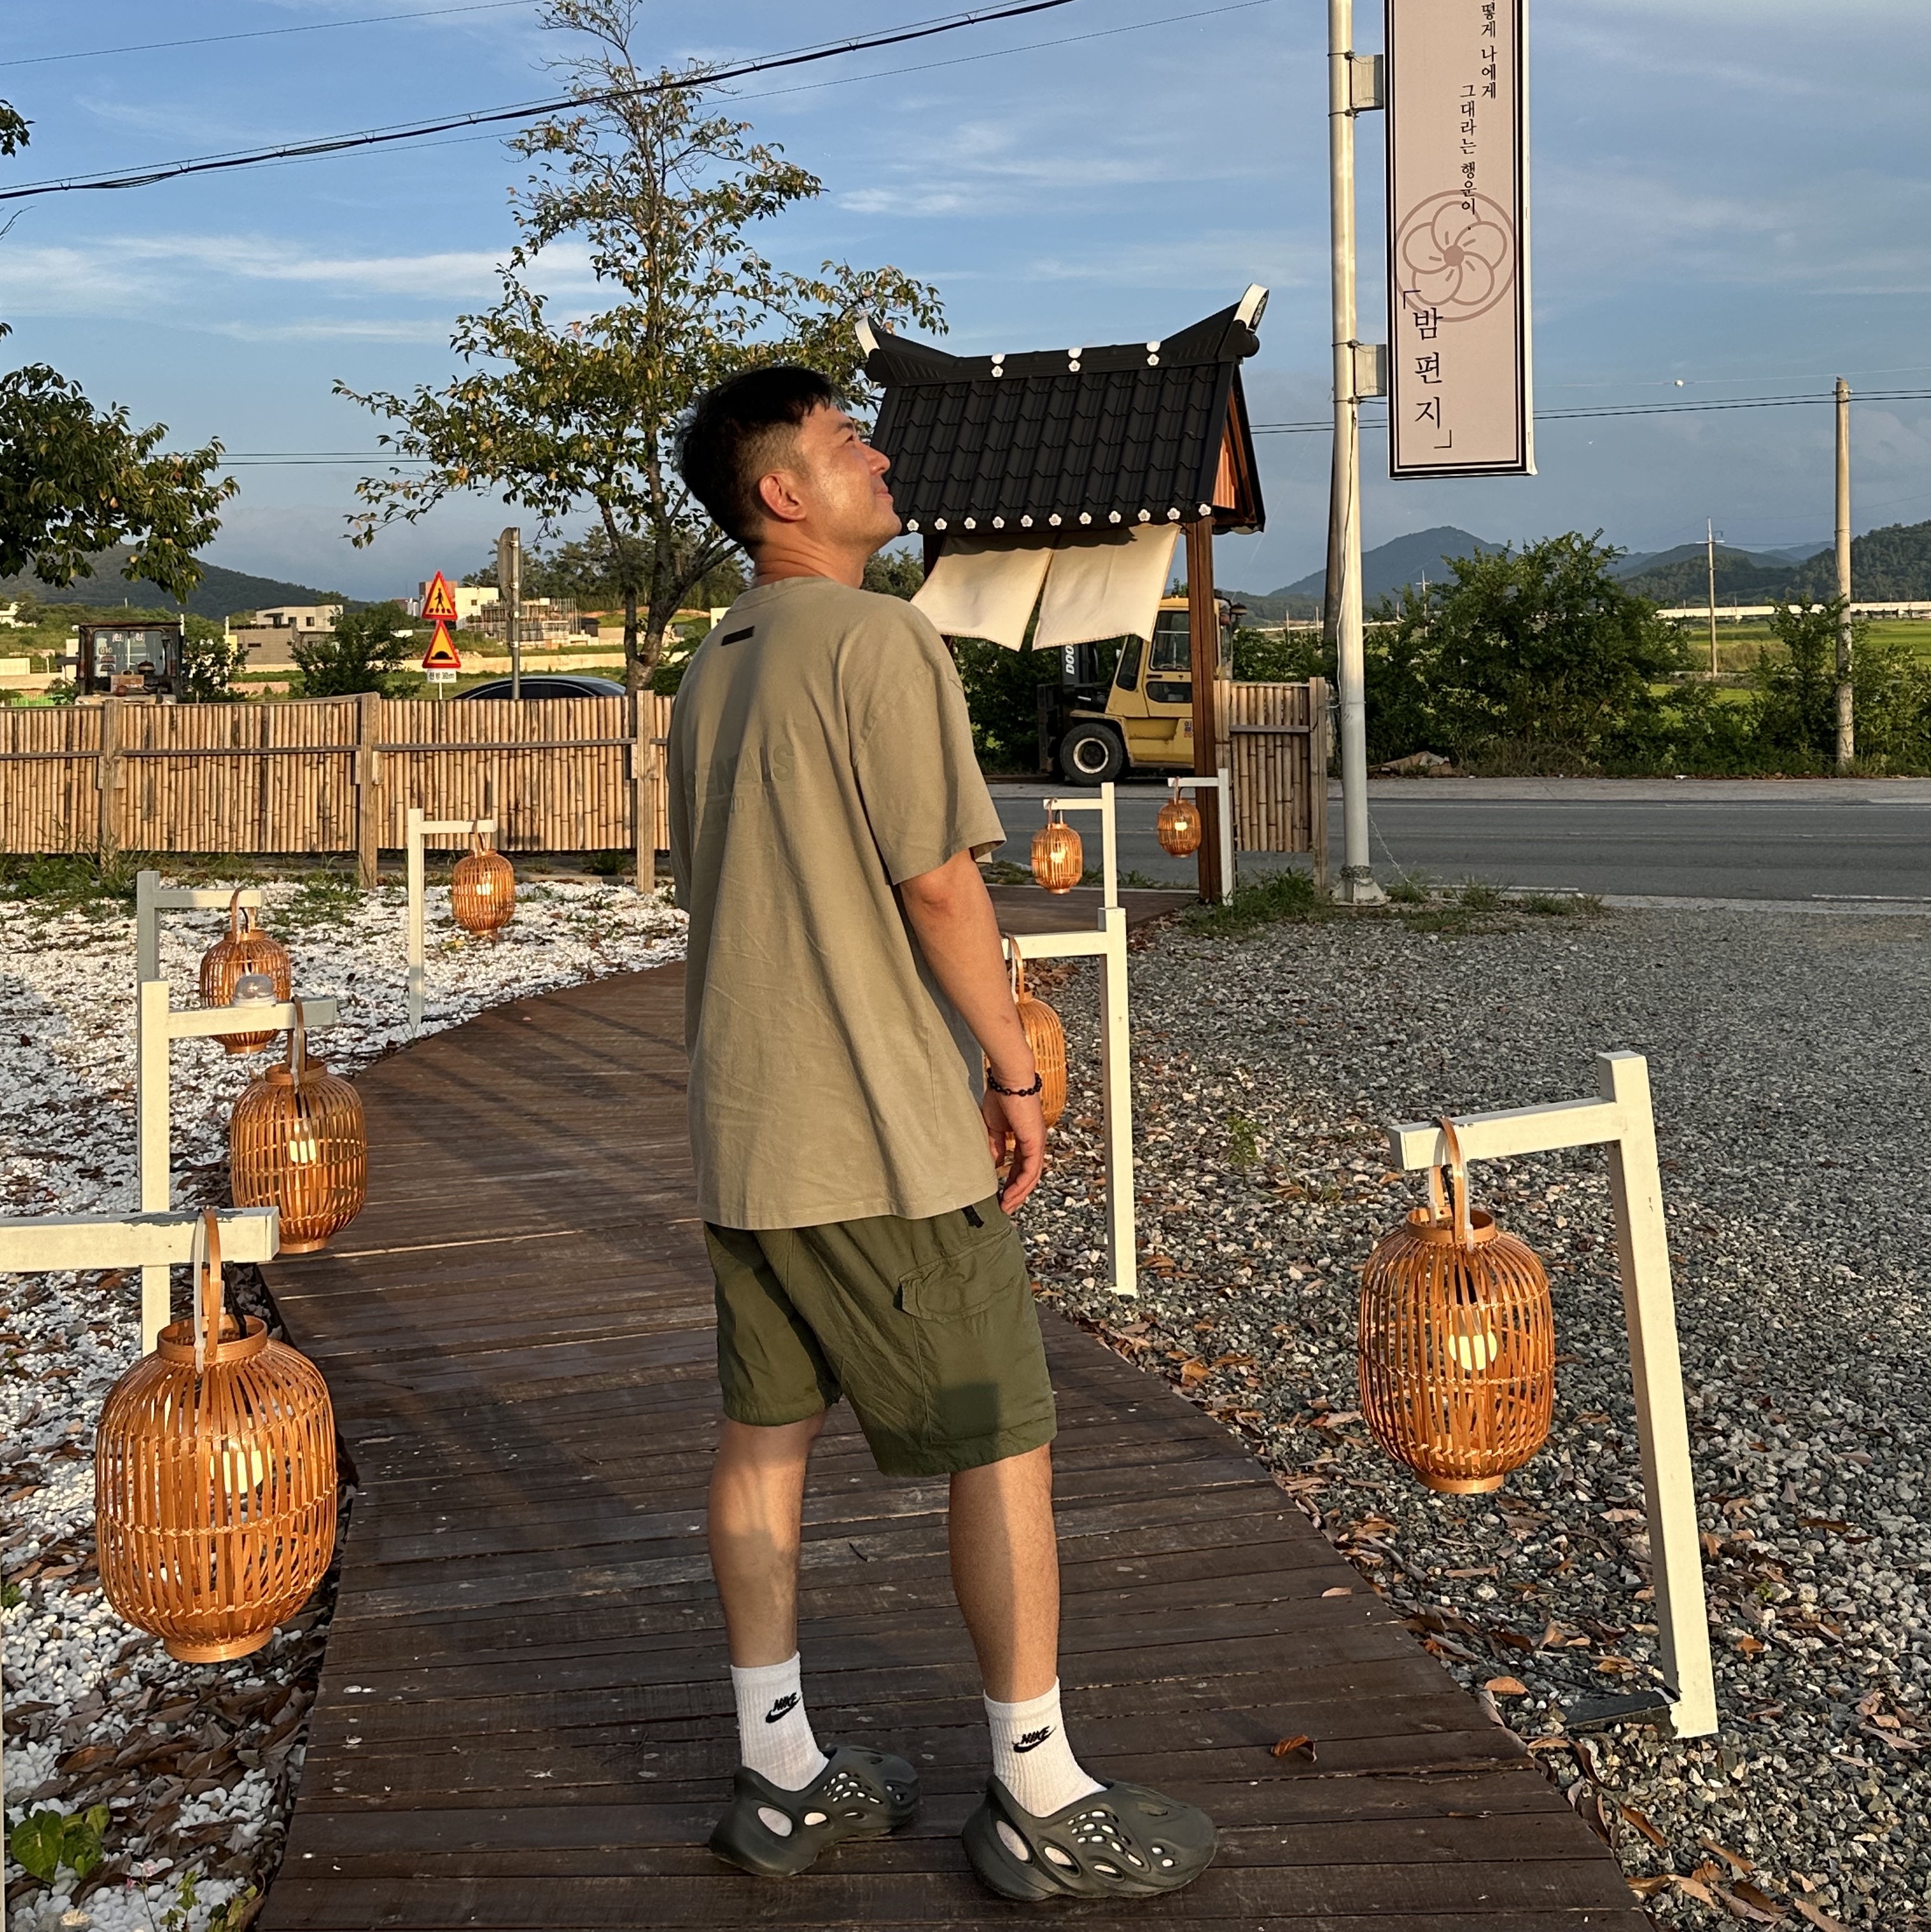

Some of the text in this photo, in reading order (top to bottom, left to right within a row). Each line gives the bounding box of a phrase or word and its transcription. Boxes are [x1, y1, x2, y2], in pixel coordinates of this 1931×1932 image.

[1481, 0, 1498, 100] 떻게 나에게
[1460, 84, 1477, 215] 그대라는 행운이
[1065, 643, 1075, 675] DOO
[773, 1692, 798, 1712] NIKE
[1020, 1725, 1051, 1744] NIKE
